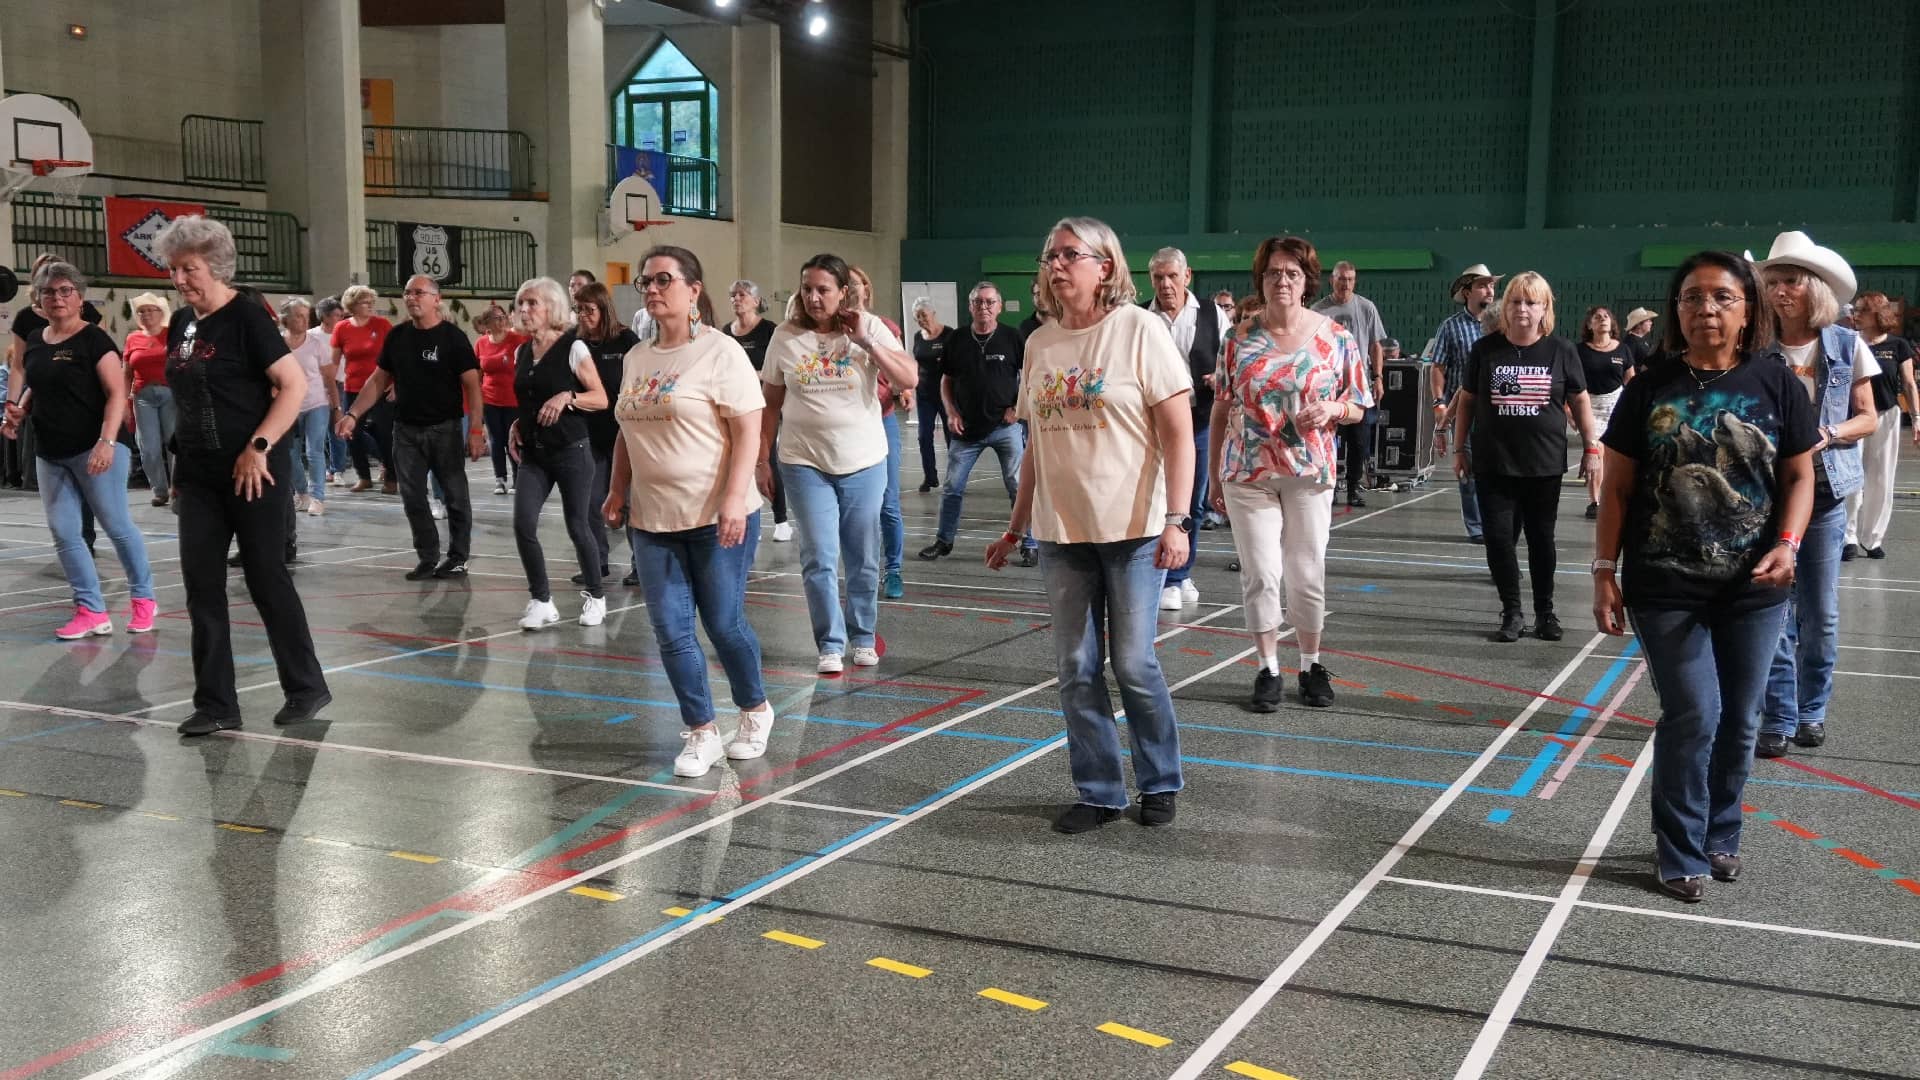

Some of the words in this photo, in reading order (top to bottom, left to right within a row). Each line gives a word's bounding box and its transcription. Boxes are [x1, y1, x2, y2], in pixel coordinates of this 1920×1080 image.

[419, 233, 441, 242] ROUTE
[426, 246, 437, 254] US
[422, 256, 441, 274] 66
[1495, 365, 1549, 376] COUNTRY
[1498, 405, 1540, 416] MUSIC
